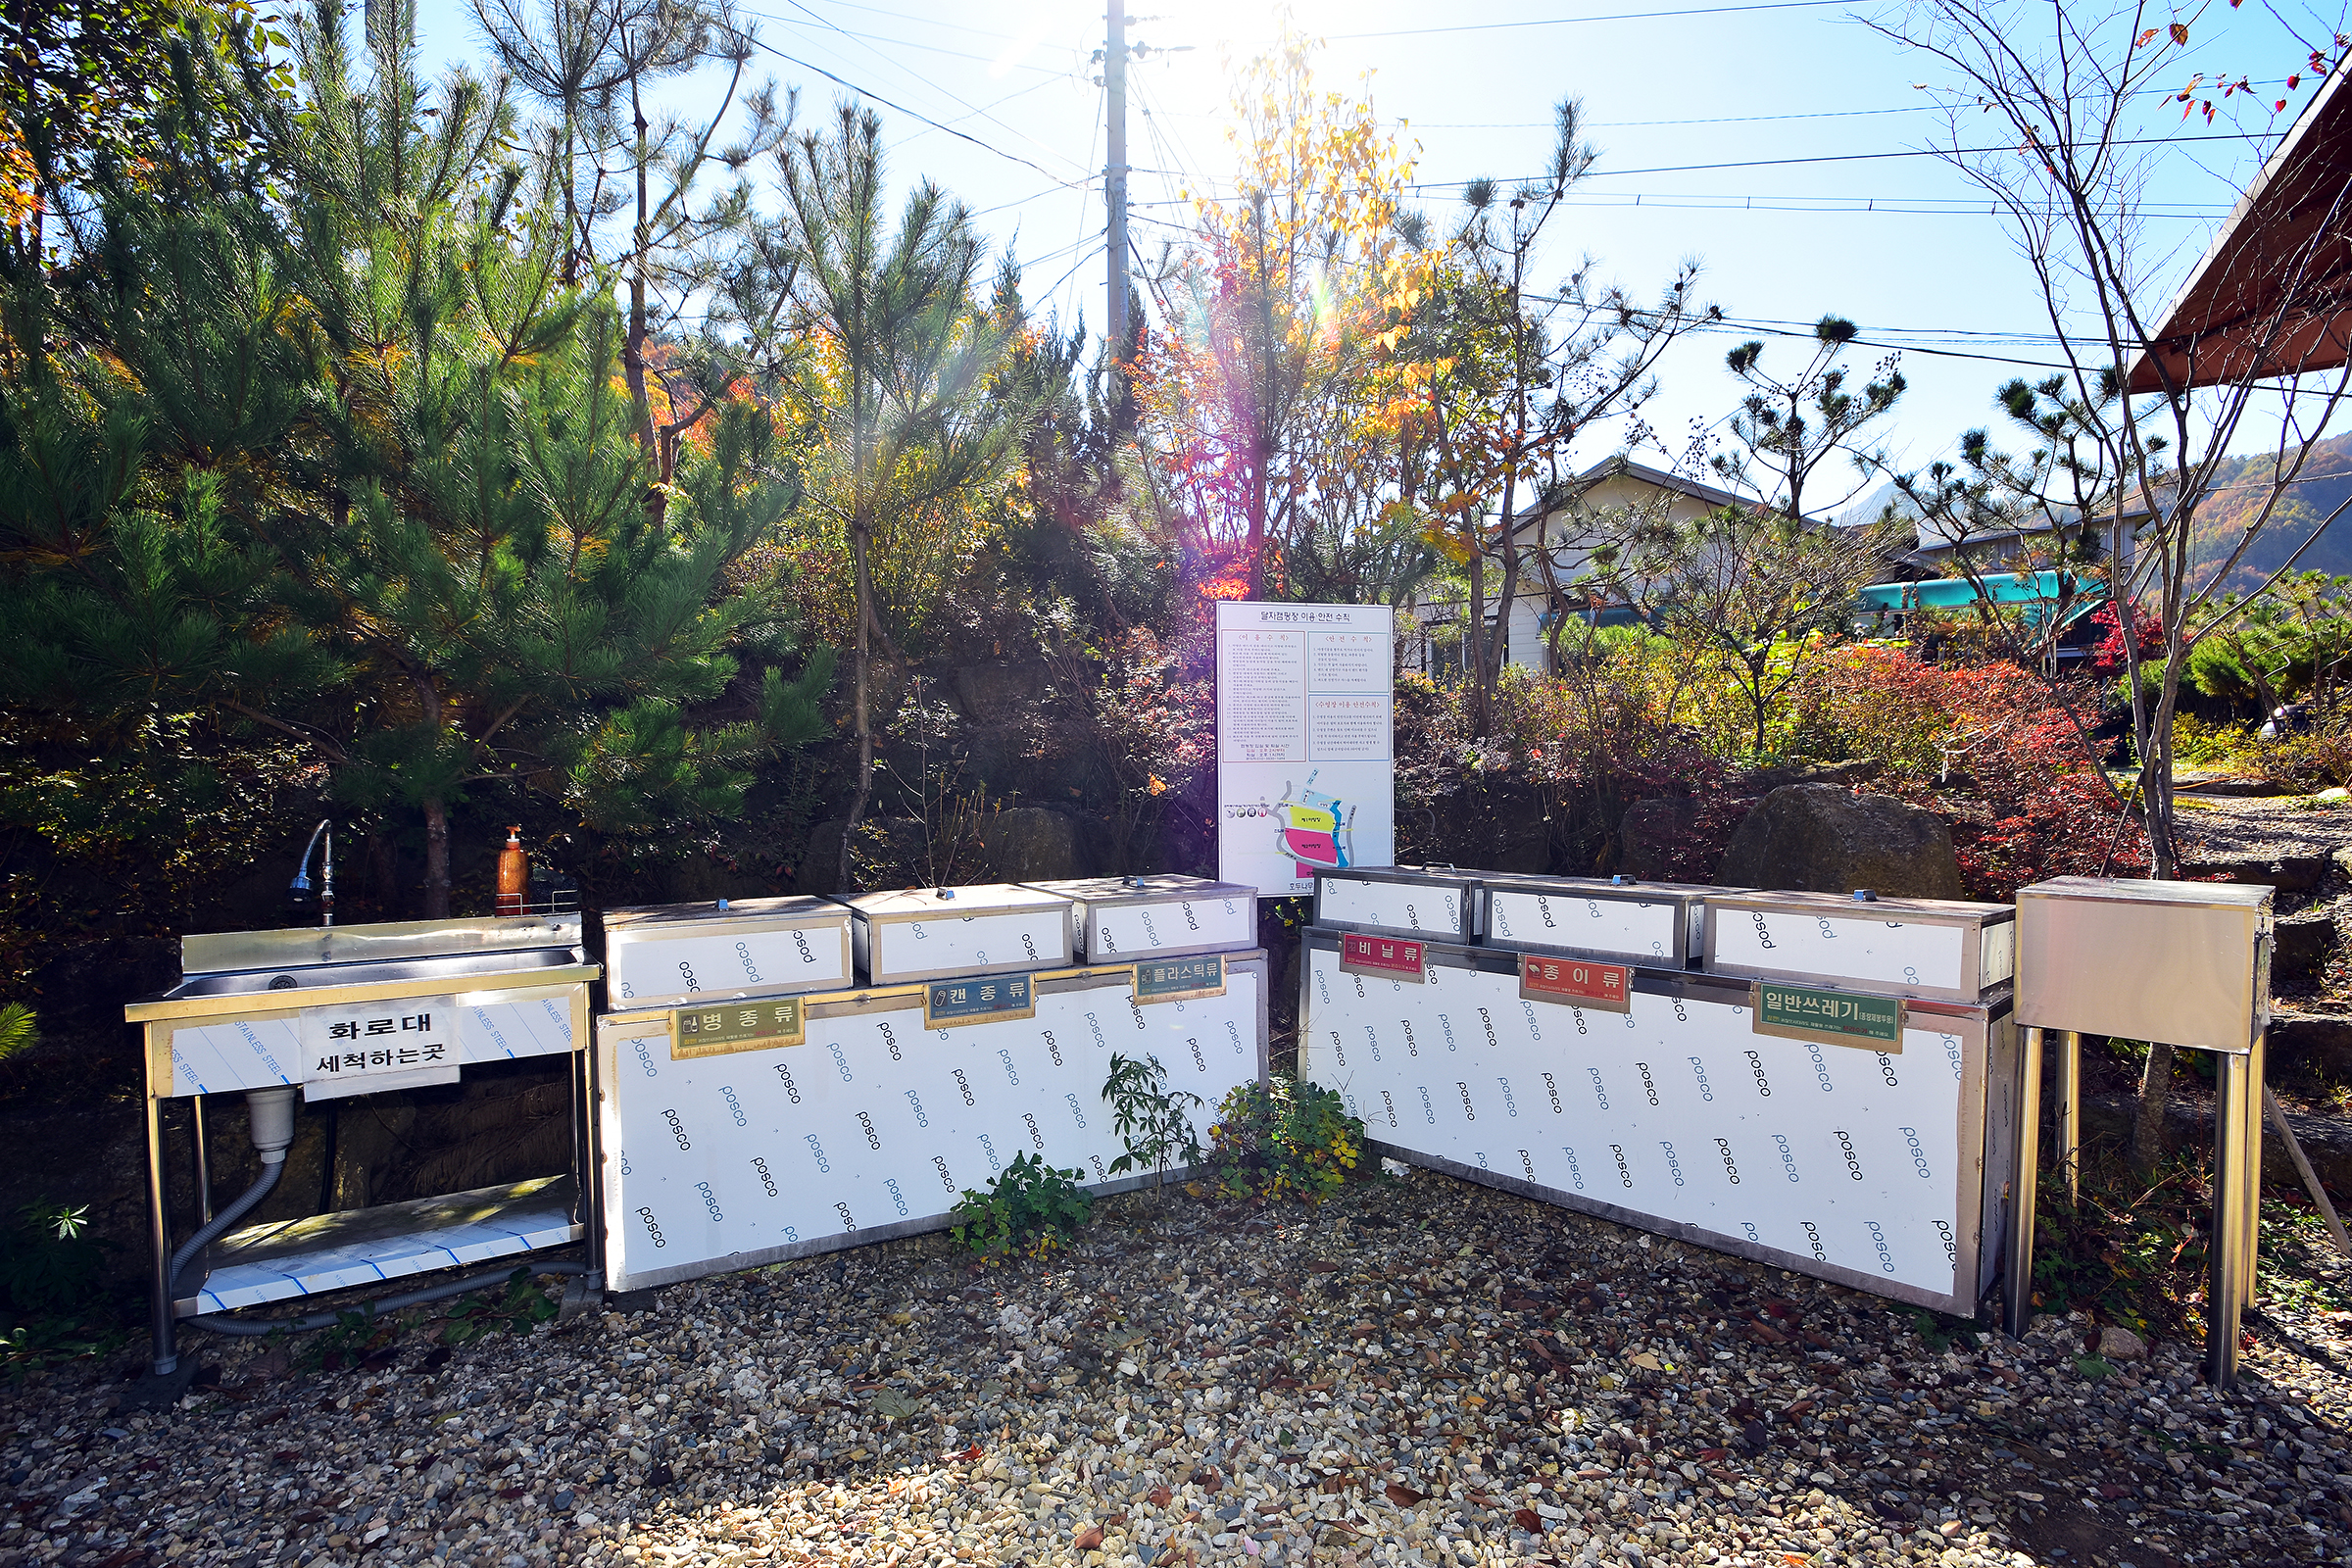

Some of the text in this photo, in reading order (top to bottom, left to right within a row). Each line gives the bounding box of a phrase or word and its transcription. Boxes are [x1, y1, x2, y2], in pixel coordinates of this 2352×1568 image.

[1336, 613, 1350, 622] 수칙
[1141, 911, 1161, 947] posco
[1494, 899, 1513, 937] posco
[735, 942, 763, 983] posco
[1154, 962, 1217, 982] 플라스틱류
[1315, 970, 1331, 1004] posco
[1766, 992, 1858, 1020] 일반쓰레기
[329, 1013, 431, 1040] 화로대
[490, 1031, 508, 1051] STEEL
[876, 1021, 902, 1061] posco
[1084, 1011, 1105, 1049] posco
[1224, 1021, 1243, 1054] posco
[1400, 1019, 1418, 1056] posco
[1439, 1013, 1456, 1053] posco
[1477, 1007, 1497, 1047] posco
[1520, 1002, 1541, 1041] posco
[316, 1043, 446, 1072] 세척하는곳
[826, 1043, 853, 1082] posco
[1041, 1030, 1062, 1067] posco
[1186, 1037, 1205, 1072] posco
[1330, 1031, 1347, 1066] posco
[1364, 1025, 1382, 1062] posco
[178, 1063, 200, 1085] STEEL
[263, 1054, 282, 1076] STEEL
[773, 1063, 802, 1103] posco
[997, 1049, 1019, 1086] posco
[1635, 1061, 1659, 1106] posco
[1688, 1056, 1713, 1102] posco
[1743, 1050, 1771, 1098] posco
[1803, 1044, 1833, 1092] posco
[717, 1086, 747, 1127] posco
[951, 1068, 974, 1107] posco
[1417, 1086, 1436, 1125] posco
[1456, 1082, 1476, 1121] posco
[1497, 1077, 1517, 1117] posco
[1541, 1072, 1562, 1114] posco
[1588, 1067, 1609, 1109] posco
[904, 1090, 929, 1129] posco
[1064, 1093, 1086, 1129] posco
[1381, 1090, 1397, 1127] posco
[661, 1108, 690, 1151] posco
[855, 1111, 880, 1151] posco
[1021, 1112, 1045, 1150] posco
[804, 1133, 830, 1174] posco
[977, 1133, 1001, 1171] posco
[1562, 1147, 1584, 1190] posco
[1609, 1144, 1633, 1189] posco
[1659, 1141, 1685, 1187] posco
[1713, 1137, 1740, 1184] posco
[1772, 1134, 1799, 1184] posco
[1833, 1130, 1864, 1182] posco
[1898, 1127, 1931, 1178] posco
[750, 1156, 778, 1198] posco
[931, 1155, 955, 1194] posco
[694, 1182, 723, 1222] posco
[883, 1178, 908, 1217] posco
[635, 1206, 666, 1249] posco
[1864, 1221, 1895, 1273] posco
